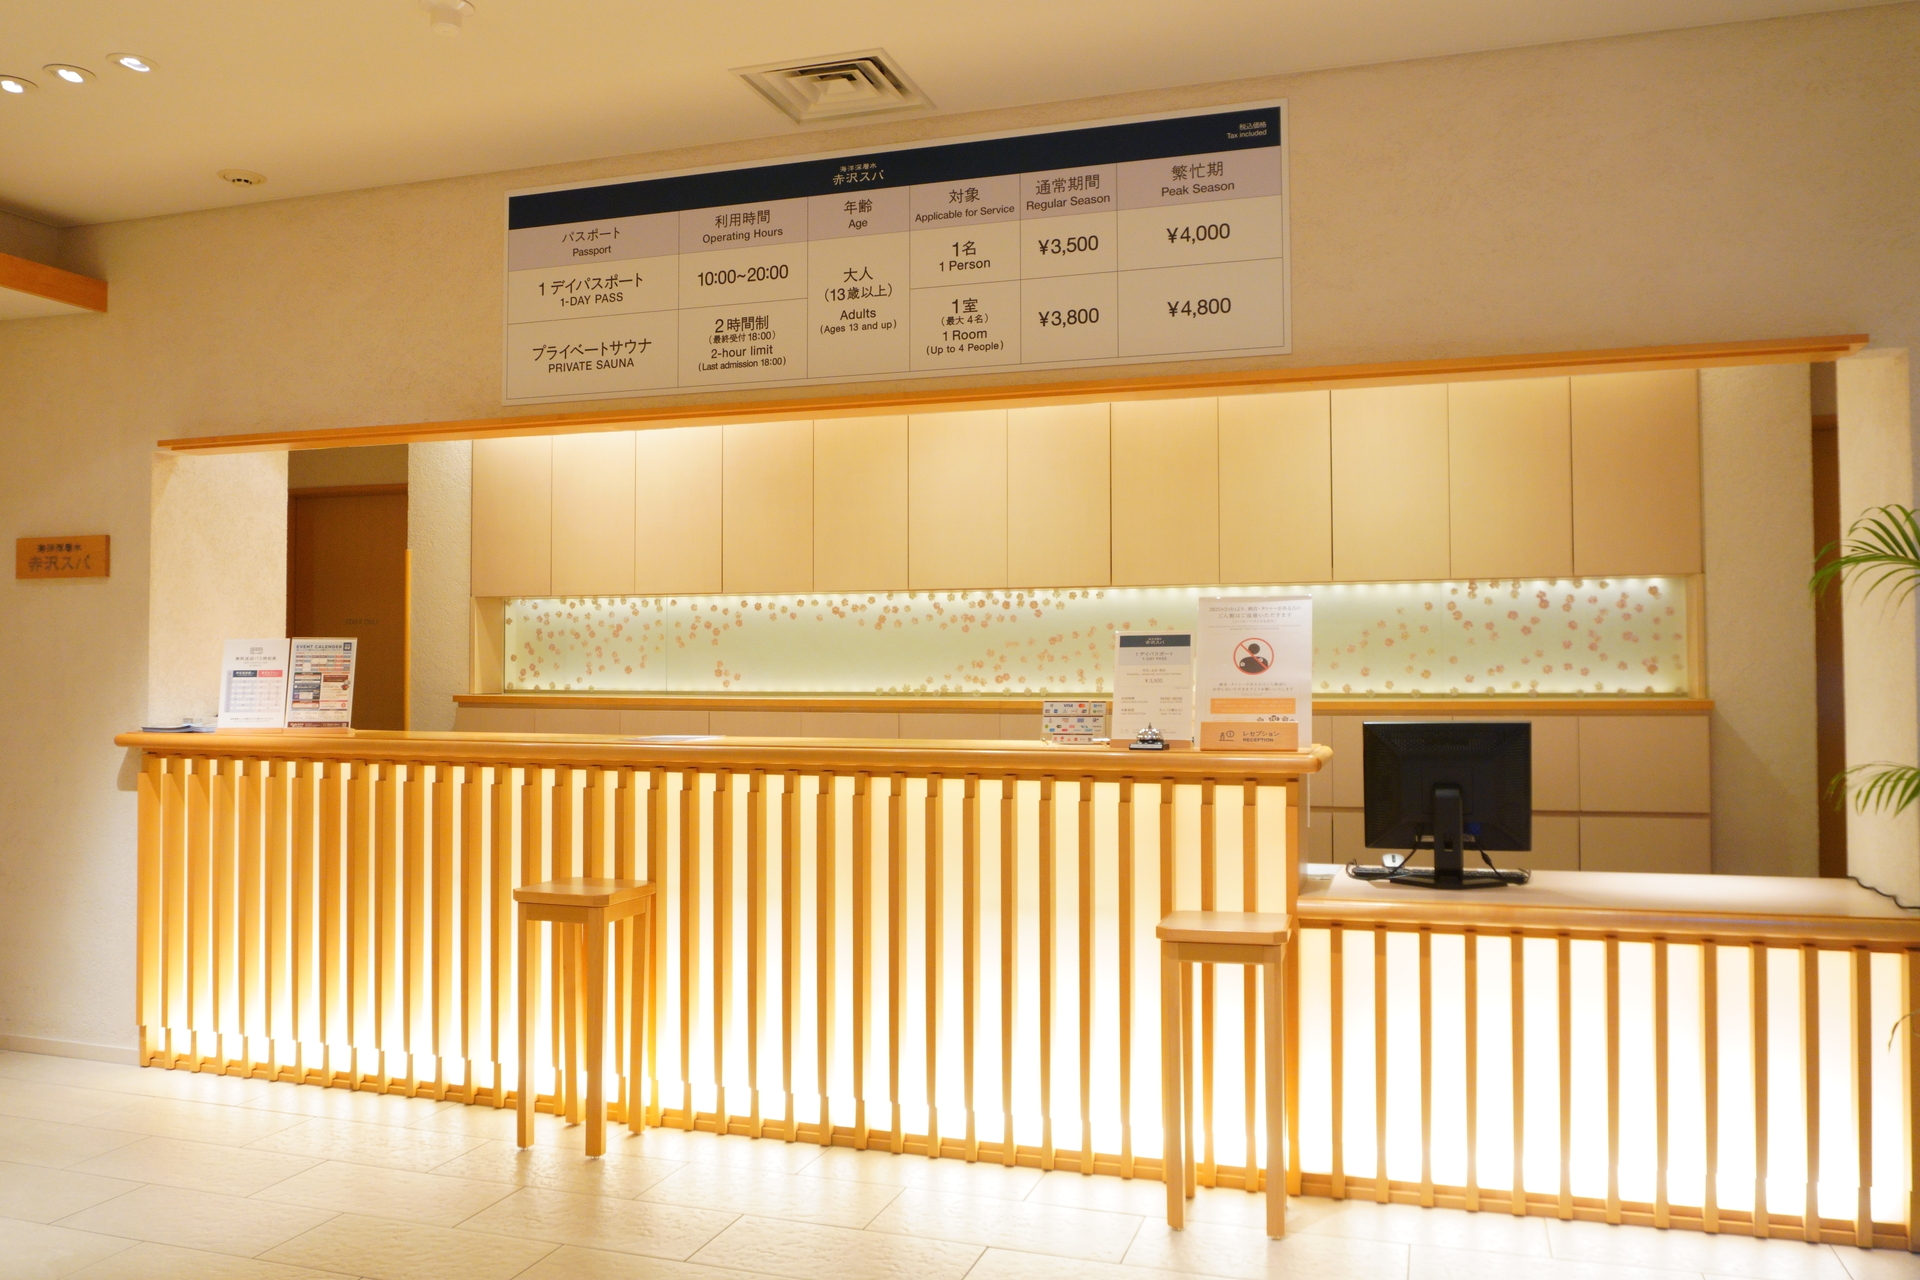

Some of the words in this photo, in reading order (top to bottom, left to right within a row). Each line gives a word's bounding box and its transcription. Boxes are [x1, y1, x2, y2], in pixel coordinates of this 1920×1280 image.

[1239, 129, 1267, 138] included
[832, 170, 884, 186] 赤沢スパ
[1172, 161, 1224, 180] 繁忙期
[1035, 174, 1100, 195] 通常期間
[1161, 185, 1189, 197] Peak
[1192, 181, 1235, 194] Season
[949, 188, 980, 204] 対象
[1026, 197, 1067, 211] Regular
[1070, 194, 1110, 206] Season
[844, 198, 873, 215] 年齢
[915, 209, 962, 223] Applicable
[965, 208, 977, 217] for
[980, 204, 1015, 215] Service
[715, 210, 771, 228] 利用時間
[848, 218, 868, 230] Age
[562, 227, 621, 243] パスポート
[702, 231, 751, 244] Operating
[753, 227, 783, 238] Hours
[1166, 223, 1230, 243] ¥4,000
[572, 245, 612, 258] Passport
[952, 241, 977, 257] 1名
[1038, 236, 1099, 256] ¥3,500
[939, 261, 945, 272] 1
[949, 258, 991, 270] Person
[843, 267, 873, 282] 大人
[560, 295, 591, 307] 1-DAY
[595, 292, 623, 303] PASS
[951, 299, 978, 314] 1室
[1167, 298, 1231, 317] ¥4,800
[840, 308, 877, 320] Adults
[1038, 308, 1099, 328] ¥3,800
[820, 323, 846, 335] (Ages
[849, 322, 859, 332] 13
[861, 321, 878, 331] and
[880, 319, 897, 332] up)
[942, 331, 948, 341] 1
[952, 329, 987, 340] Room
[533, 338, 652, 362] プライベートサウナ
[711, 346, 747, 359] 2-hour
[750, 344, 773, 356] limit
[926, 344, 943, 356] (Up
[946, 344, 955, 353] to
[958, 344, 964, 353] 4
[967, 340, 1004, 353] People)
[548, 360, 592, 374] PRIVATE
[596, 358, 634, 370] SAUNA
[698, 361, 718, 373] (Last
[719, 359, 758, 370] admission
[760, 356, 786, 368] 18:00)
[29, 555, 91, 572] 赤沢スパ
